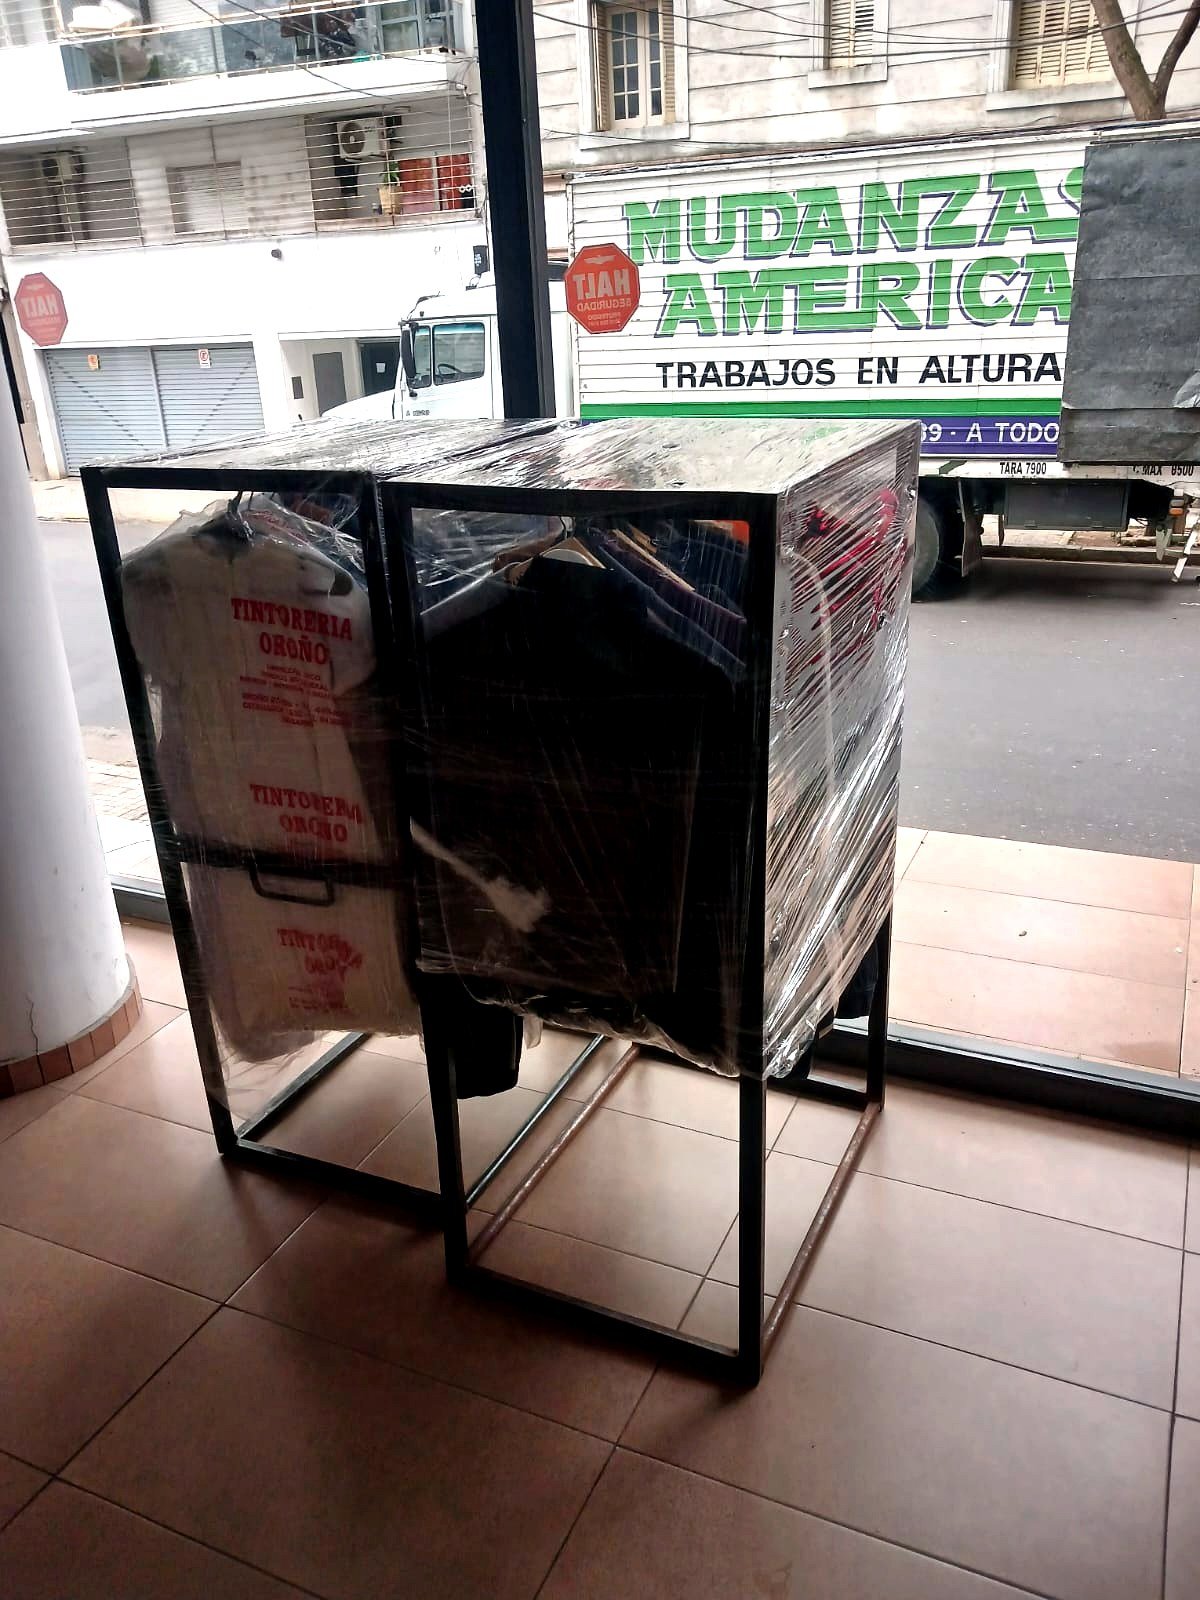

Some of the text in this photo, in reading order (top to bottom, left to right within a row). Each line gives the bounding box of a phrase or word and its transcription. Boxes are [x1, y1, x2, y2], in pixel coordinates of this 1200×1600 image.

[654, 251, 1072, 339] AMERICA
[656, 352, 1063, 388] TRABAJOS EN ALTURA
[965, 422, 983, 443] A
[994, 422, 1060, 443] TODO
[1000, 461, 1047, 475] TARA 7900
[231, 598, 352, 641] TINTORERIA
[259, 631, 330, 665] OROÑO
